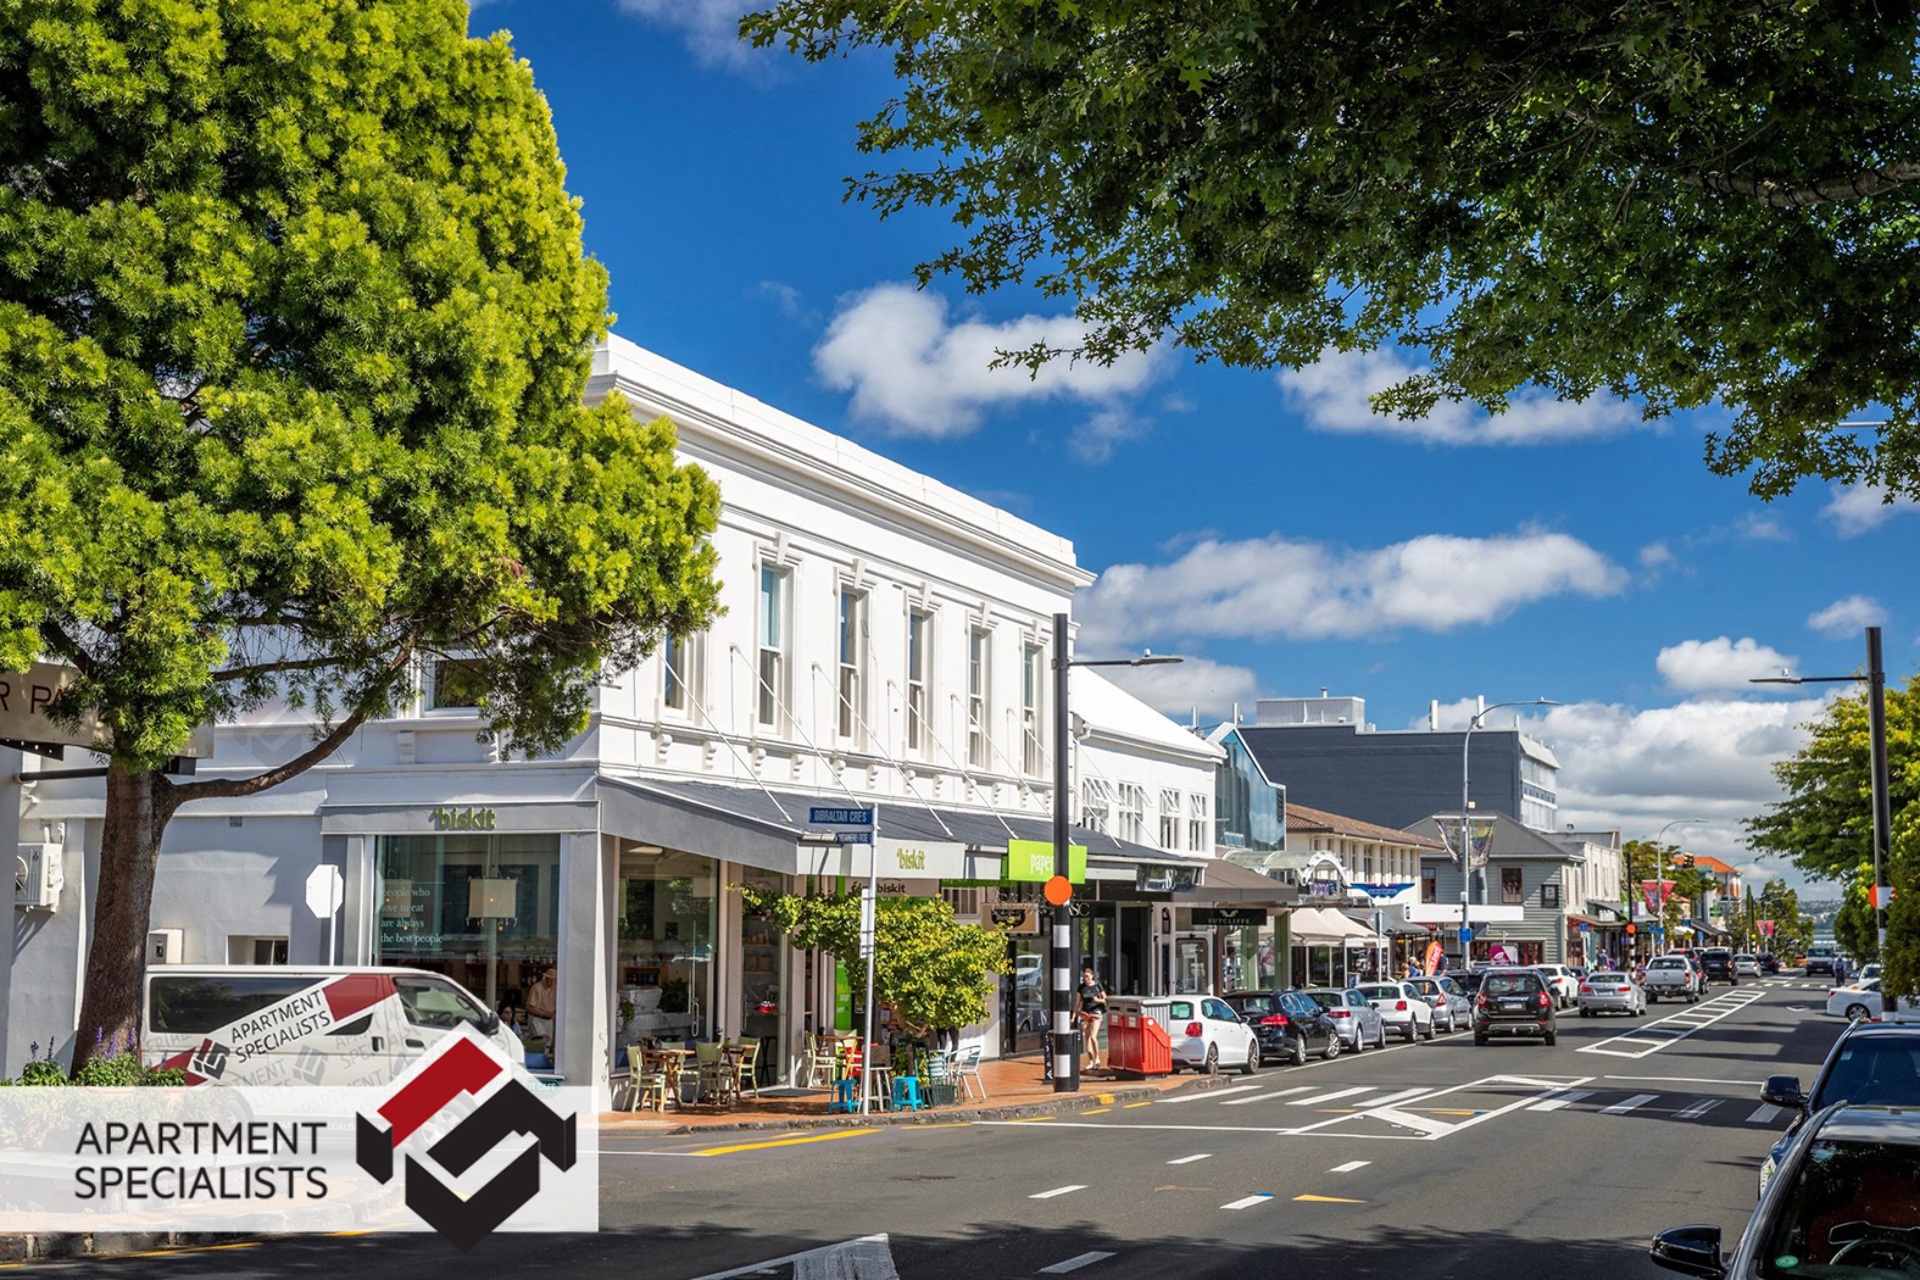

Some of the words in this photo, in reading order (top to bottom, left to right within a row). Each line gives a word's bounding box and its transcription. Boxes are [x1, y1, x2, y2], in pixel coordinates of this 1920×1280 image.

[434, 806, 496, 830] biskit
[814, 809, 848, 822] GIBRALTAR
[849, 811, 867, 823] CRES
[897, 847, 926, 870] biskit
[412, 887, 430, 896] who
[877, 882, 906, 893] biskit
[411, 904, 424, 912] eat
[380, 933, 394, 943] the
[396, 933, 412, 943] best
[415, 933, 444, 946] people
[231, 989, 322, 1043] APARTMENT
[235, 1010, 331, 1063] SPECIALISTS
